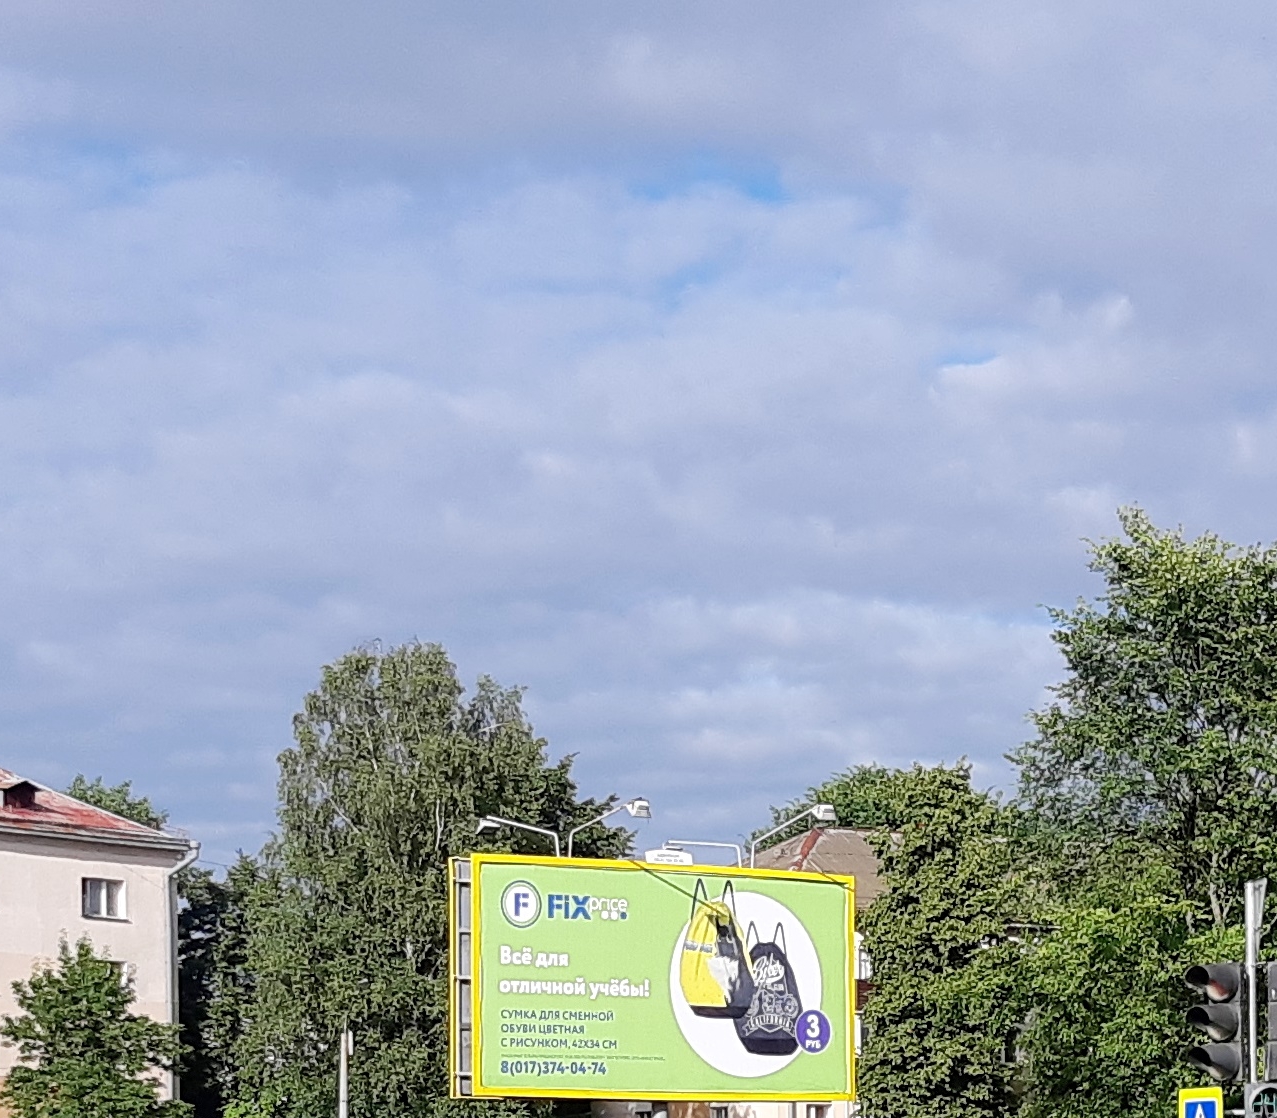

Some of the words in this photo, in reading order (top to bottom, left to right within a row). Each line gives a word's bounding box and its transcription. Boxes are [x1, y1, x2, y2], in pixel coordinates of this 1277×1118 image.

[513, 892, 530, 917] F
[499, 945, 533, 965] Всё
[535, 952, 570, 968] для
[499, 977, 586, 996] отличной
[589, 978, 651, 1000] учёбы!
[500, 1009, 537, 1020] СУМКА
[539, 1010, 560, 1021] ДЛЯ
[562, 1010, 614, 1021] СМЕННОЙ
[500, 1023, 537, 1034] ОБУВИ
[538, 1024, 585, 1035] ЦВЕТНАЯ
[806, 1014, 821, 1039] 3
[509, 1038, 571, 1050] РИСУНКОМ,
[602, 1040, 618, 1049] СМ
[805, 1040, 822, 1049] РУБ
[500, 1060, 607, 1077] 8(017)374-04-74
